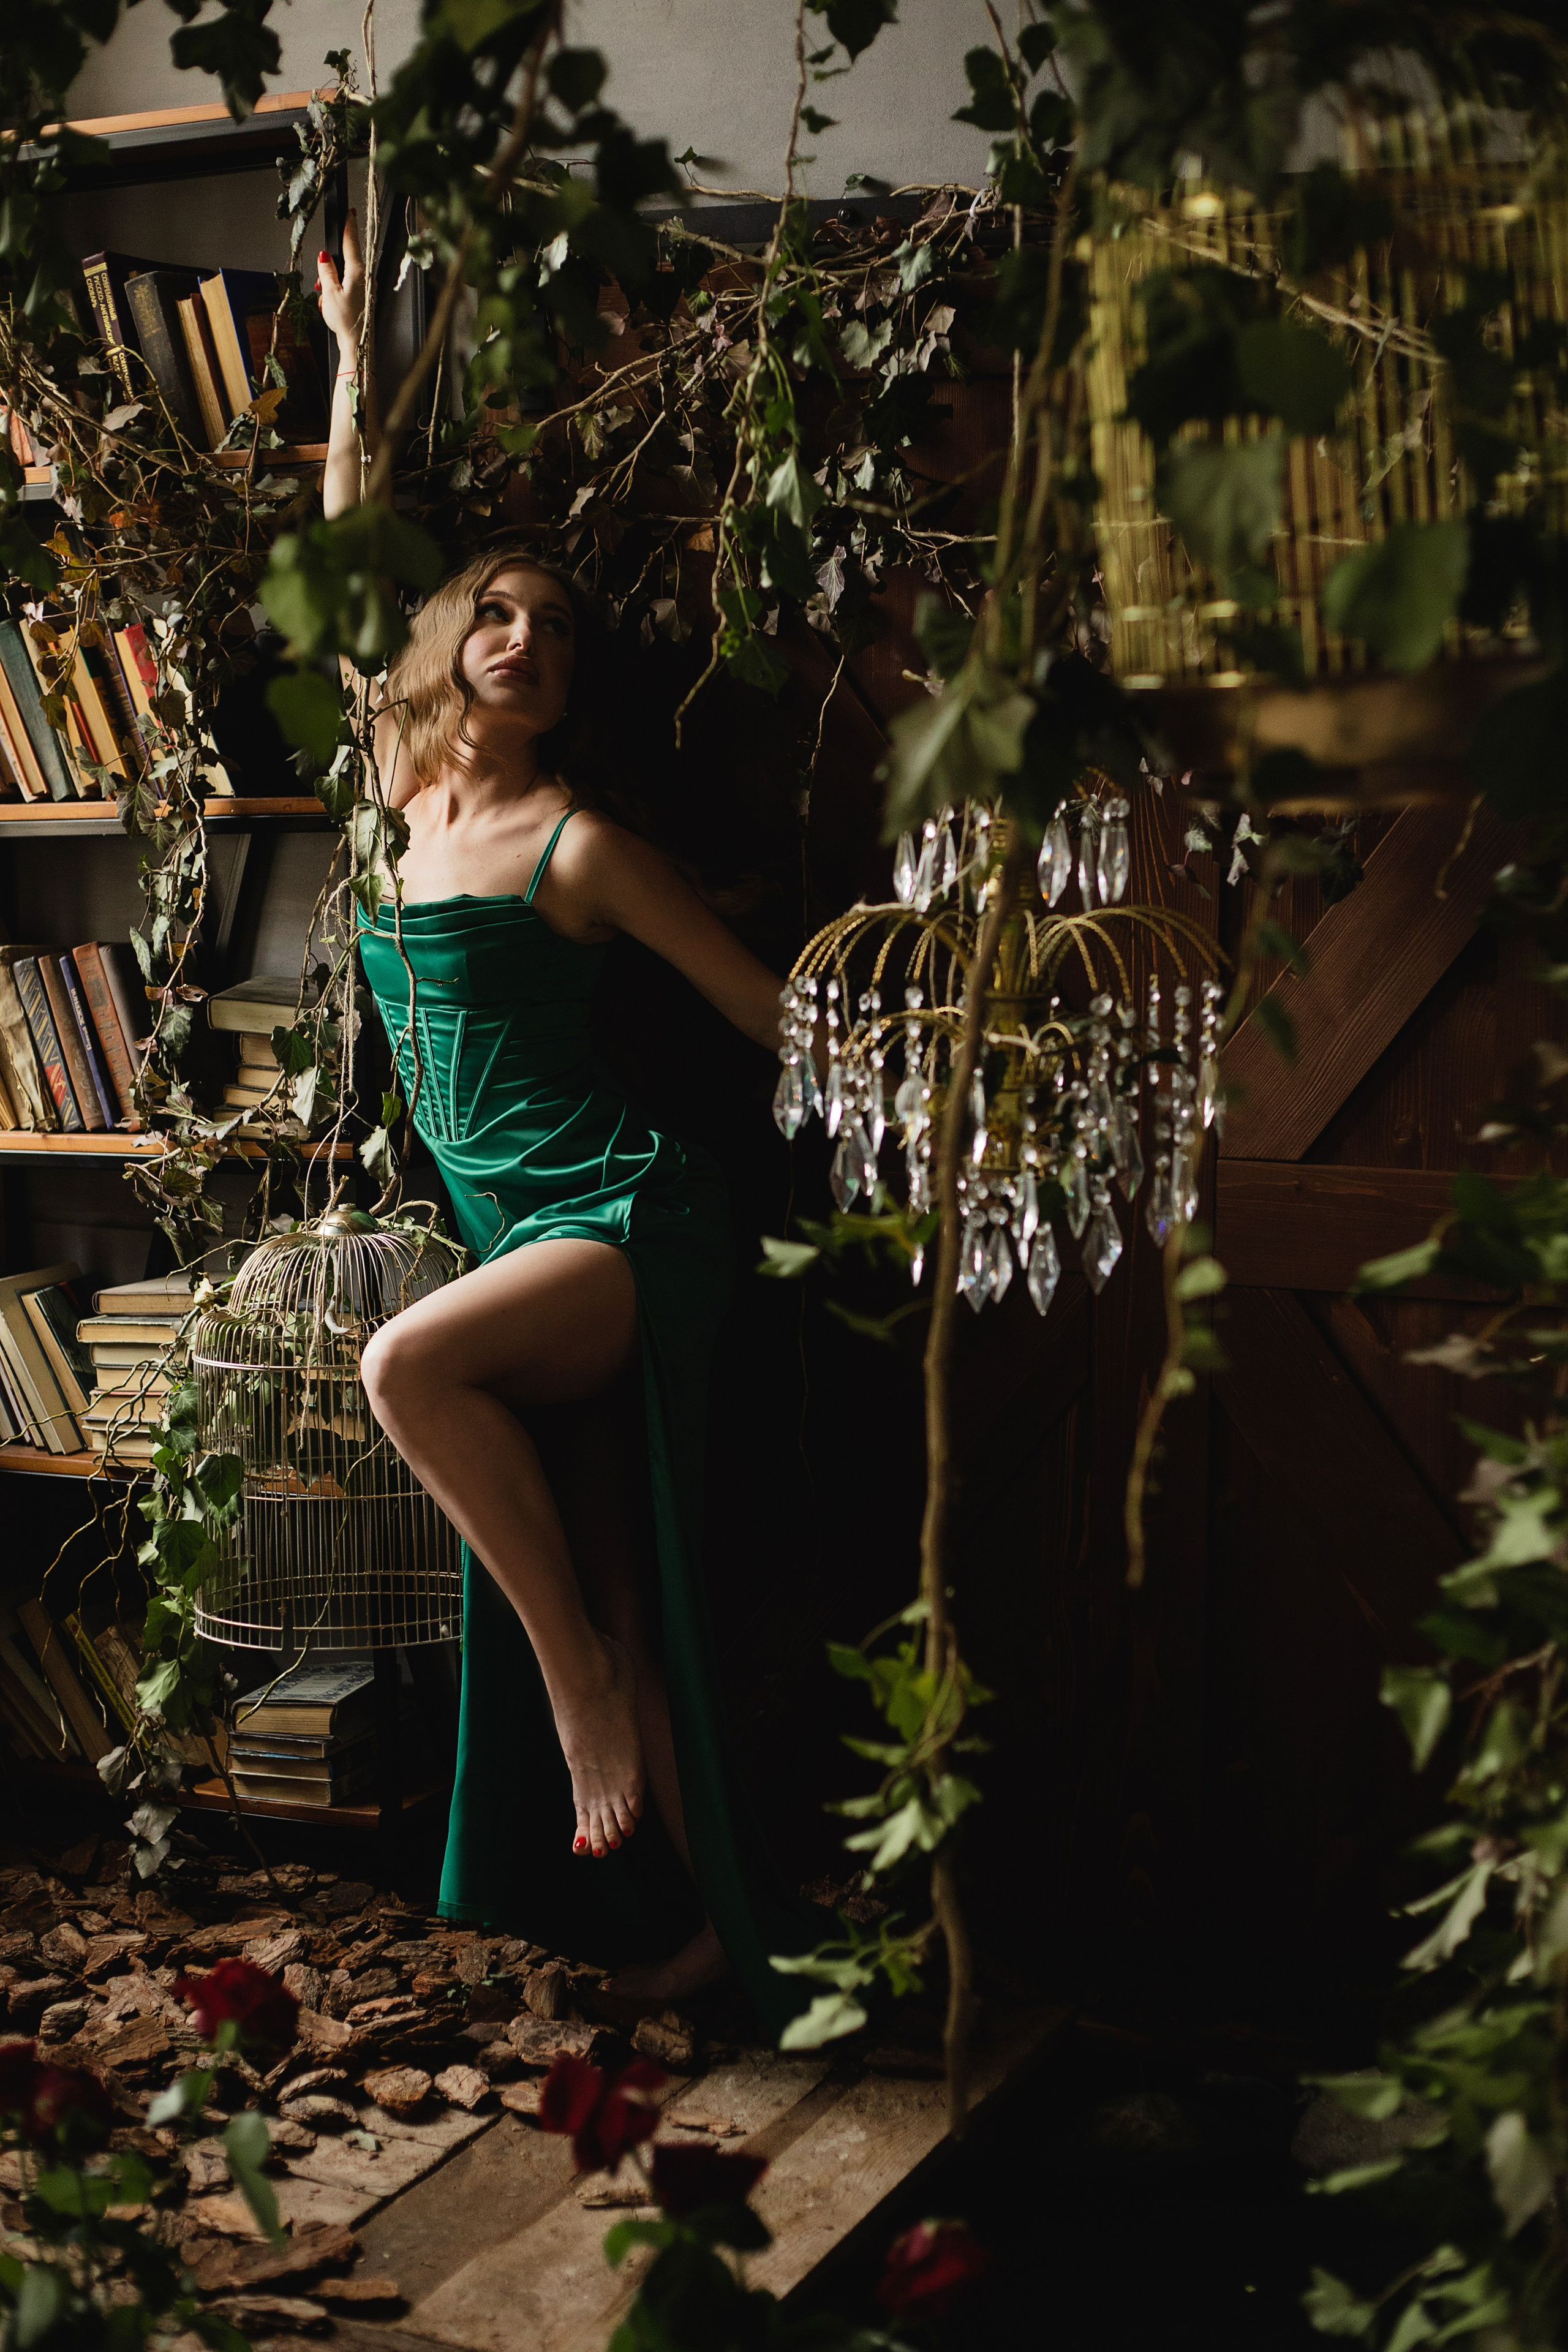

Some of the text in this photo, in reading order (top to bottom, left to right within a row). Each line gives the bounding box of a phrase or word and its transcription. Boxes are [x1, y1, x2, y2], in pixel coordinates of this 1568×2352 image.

[86, 278, 97, 308] СЛОВАРЬ
[101, 273, 117, 321] СОВРЕМЕННЫЙ
[119, 352, 134, 399] CONTEMPORAR
